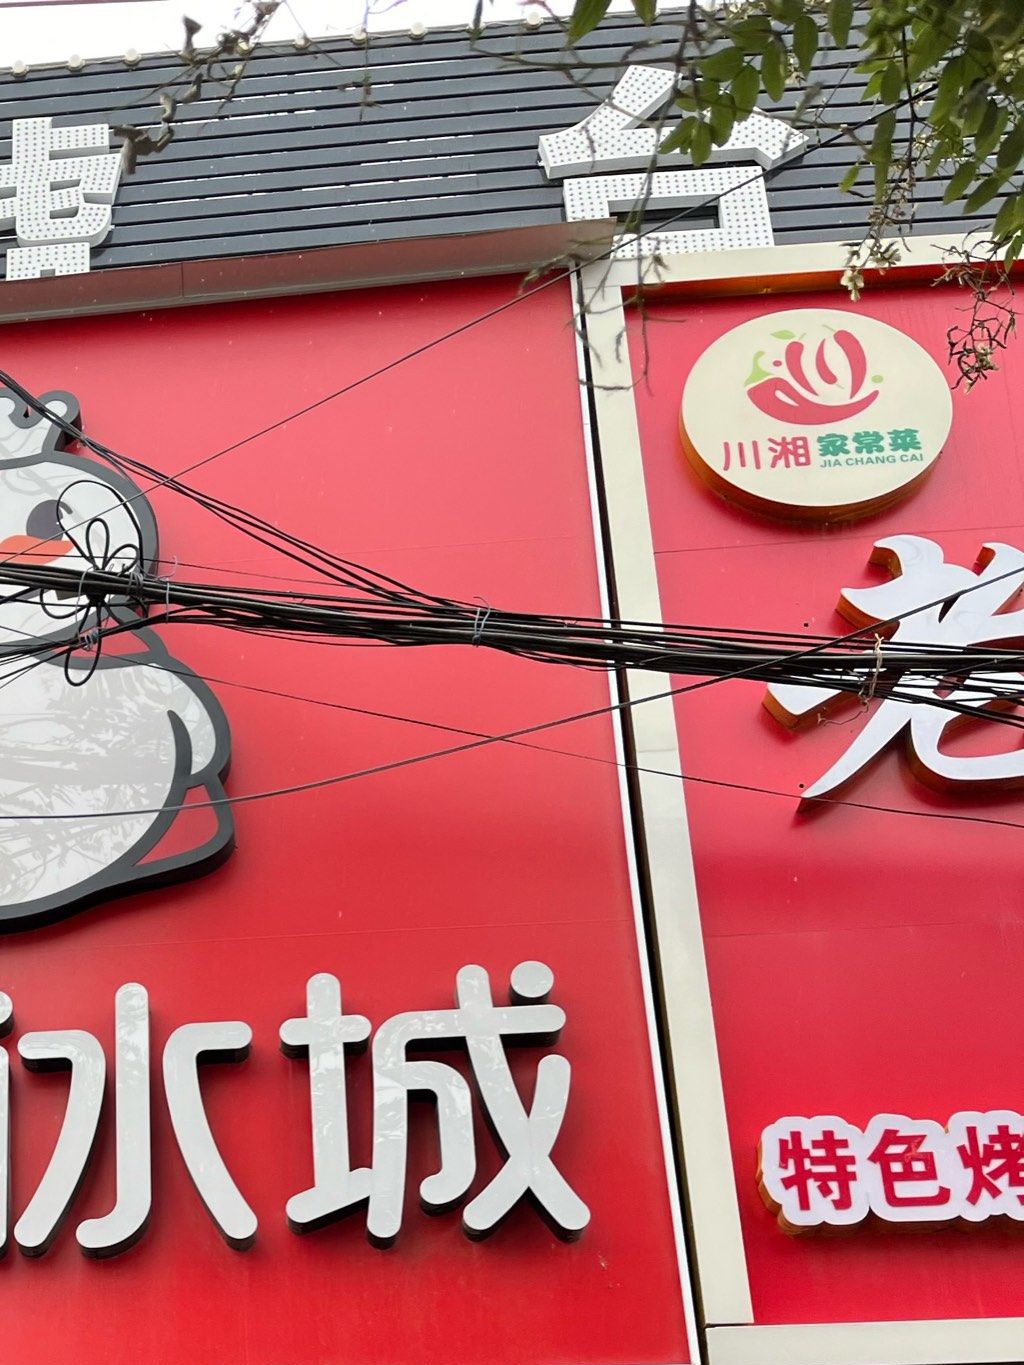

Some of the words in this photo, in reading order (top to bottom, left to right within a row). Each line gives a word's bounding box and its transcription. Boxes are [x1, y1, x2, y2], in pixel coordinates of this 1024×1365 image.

[723, 436, 811, 471] 川湘
[817, 428, 922, 457] 家常菜
[820, 459, 842, 468] JIA
[846, 455, 896, 466] CHANG
[900, 453, 924, 463] CAI
